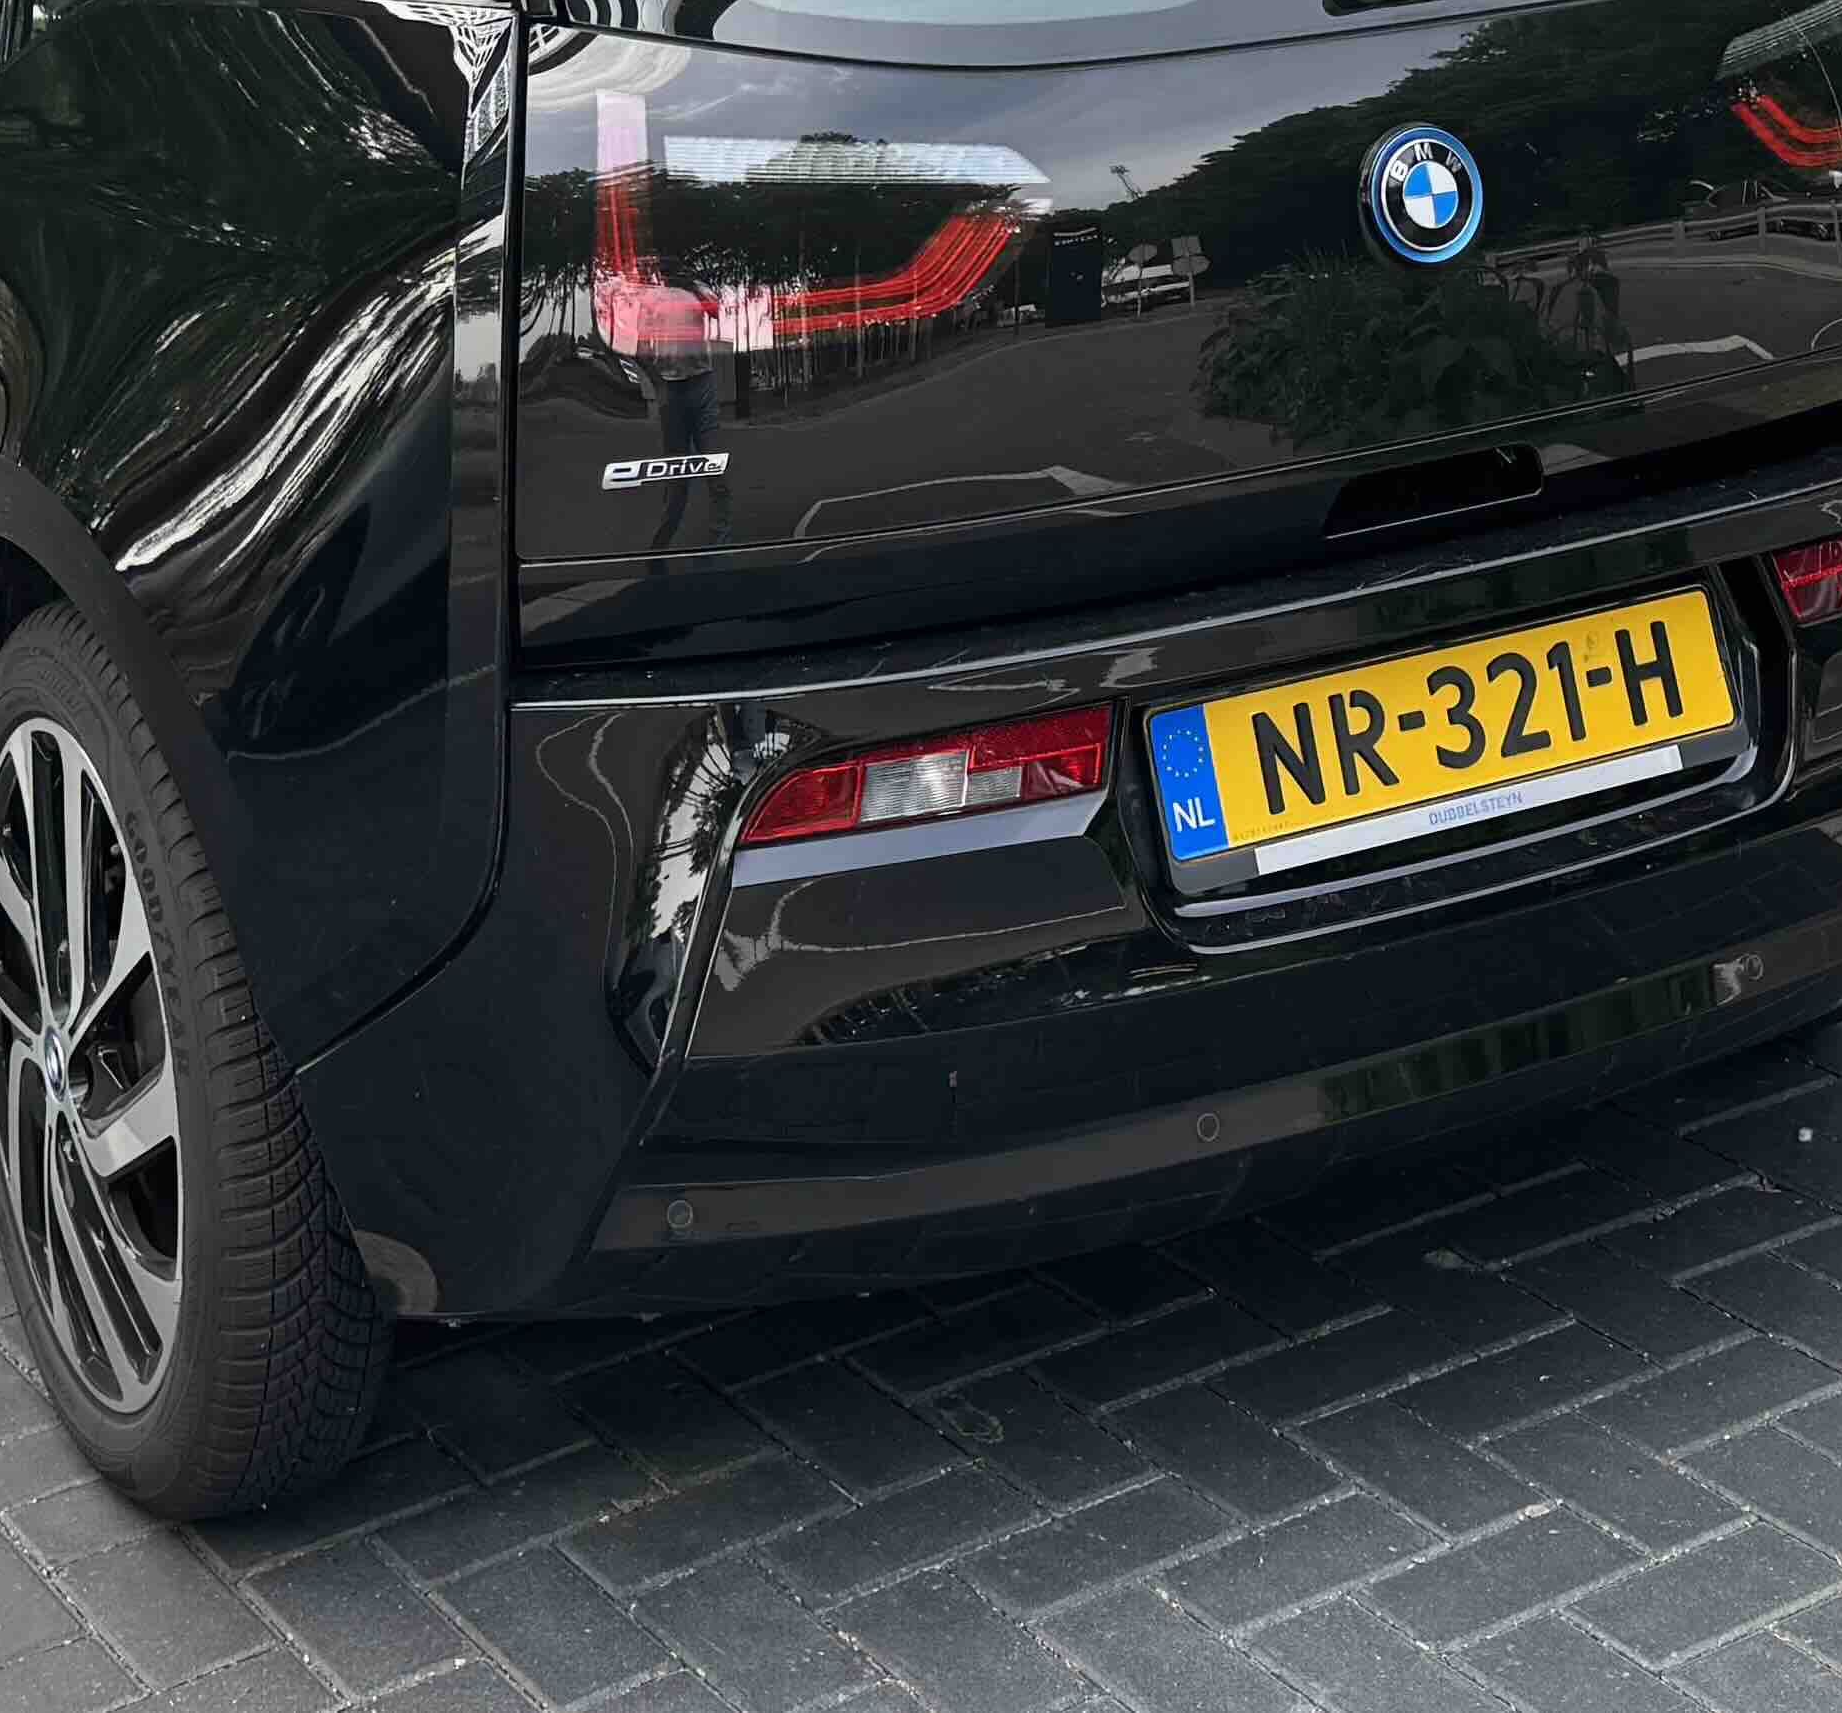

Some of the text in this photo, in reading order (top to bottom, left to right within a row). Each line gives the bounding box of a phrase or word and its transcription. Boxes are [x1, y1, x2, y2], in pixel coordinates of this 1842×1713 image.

[1390, 142, 1462, 183] BMW
[1252, 619, 1684, 816] NR-321-H
[1172, 796, 1216, 834] NL
